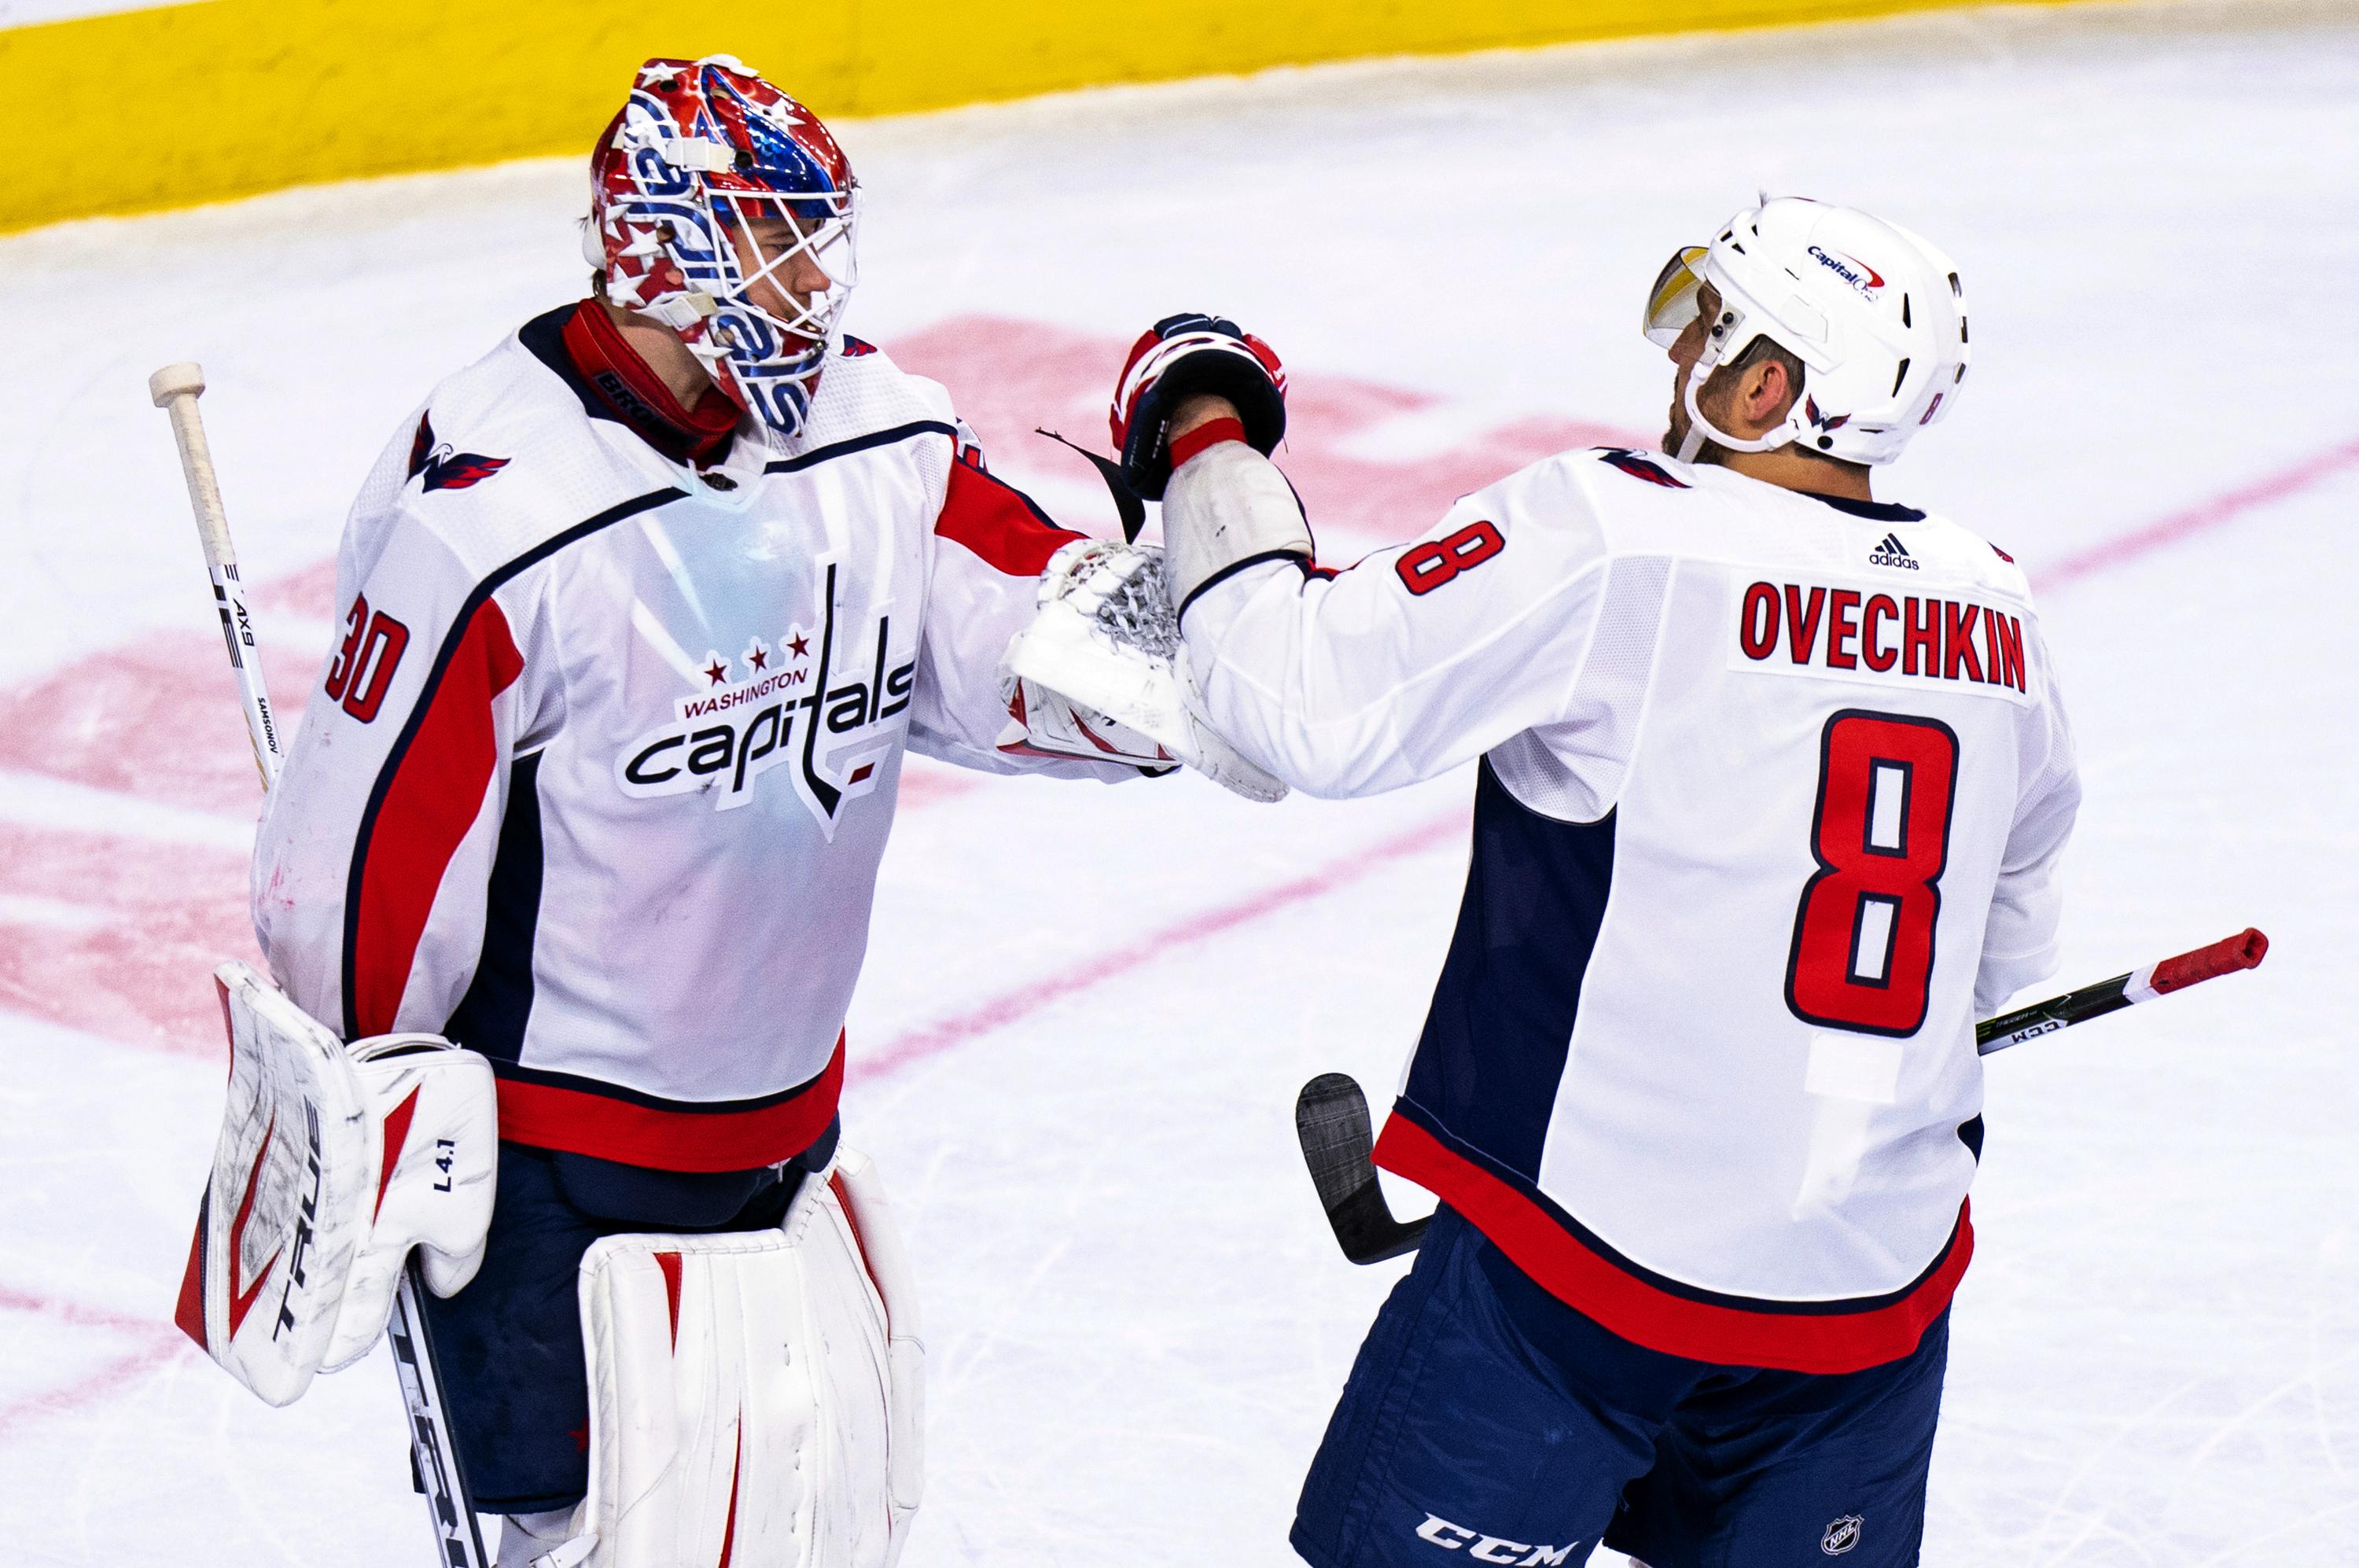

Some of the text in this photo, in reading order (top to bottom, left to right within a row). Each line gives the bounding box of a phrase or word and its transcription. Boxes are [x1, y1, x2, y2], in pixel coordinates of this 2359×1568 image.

[1807, 245, 1858, 282] Capital
[1919, 392, 1944, 425] 8
[1395, 520, 1506, 596] 8
[1869, 552, 1919, 571] adidas
[233, 597, 255, 647] AX9
[1739, 581, 2026, 694] OVECHKIN
[325, 591, 410, 724] 30
[684, 668, 808, 719] WASHINGTON
[258, 697, 278, 754] SAMSONOV
[1783, 708, 1960, 1039] 8
[2011, 1021, 2060, 1043] CCM
[1415, 1511, 1580, 1567] CCM
[1828, 1522, 1856, 1549] NHL
